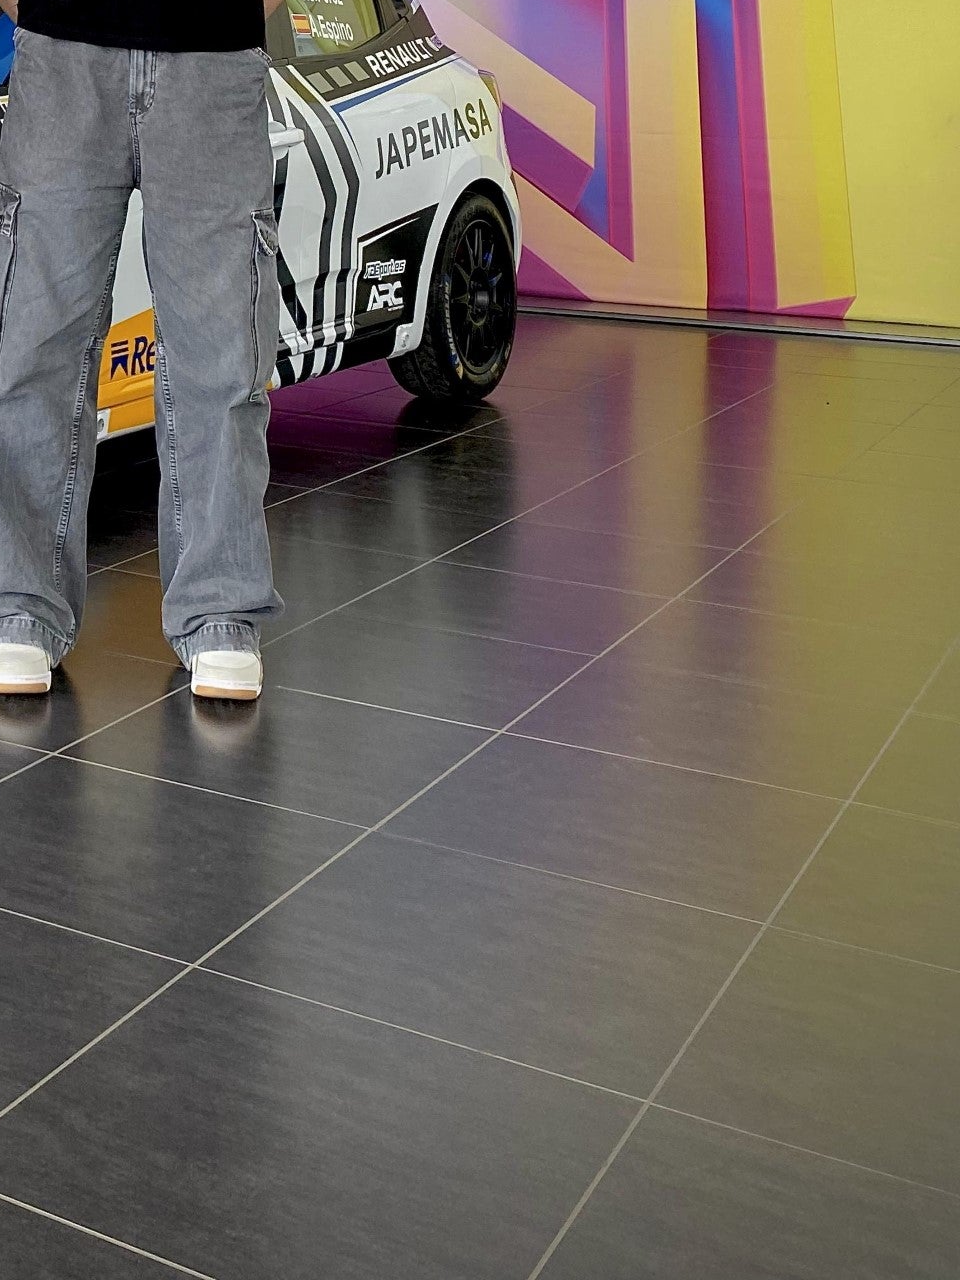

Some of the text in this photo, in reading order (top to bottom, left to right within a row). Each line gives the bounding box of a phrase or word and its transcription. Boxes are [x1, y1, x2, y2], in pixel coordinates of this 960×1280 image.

[309, 14, 354, 46] A.Espino
[365, 38, 433, 77] RENAULT
[376, 99, 493, 179] JAPEMASA
[367, 281, 403, 311] ARC
